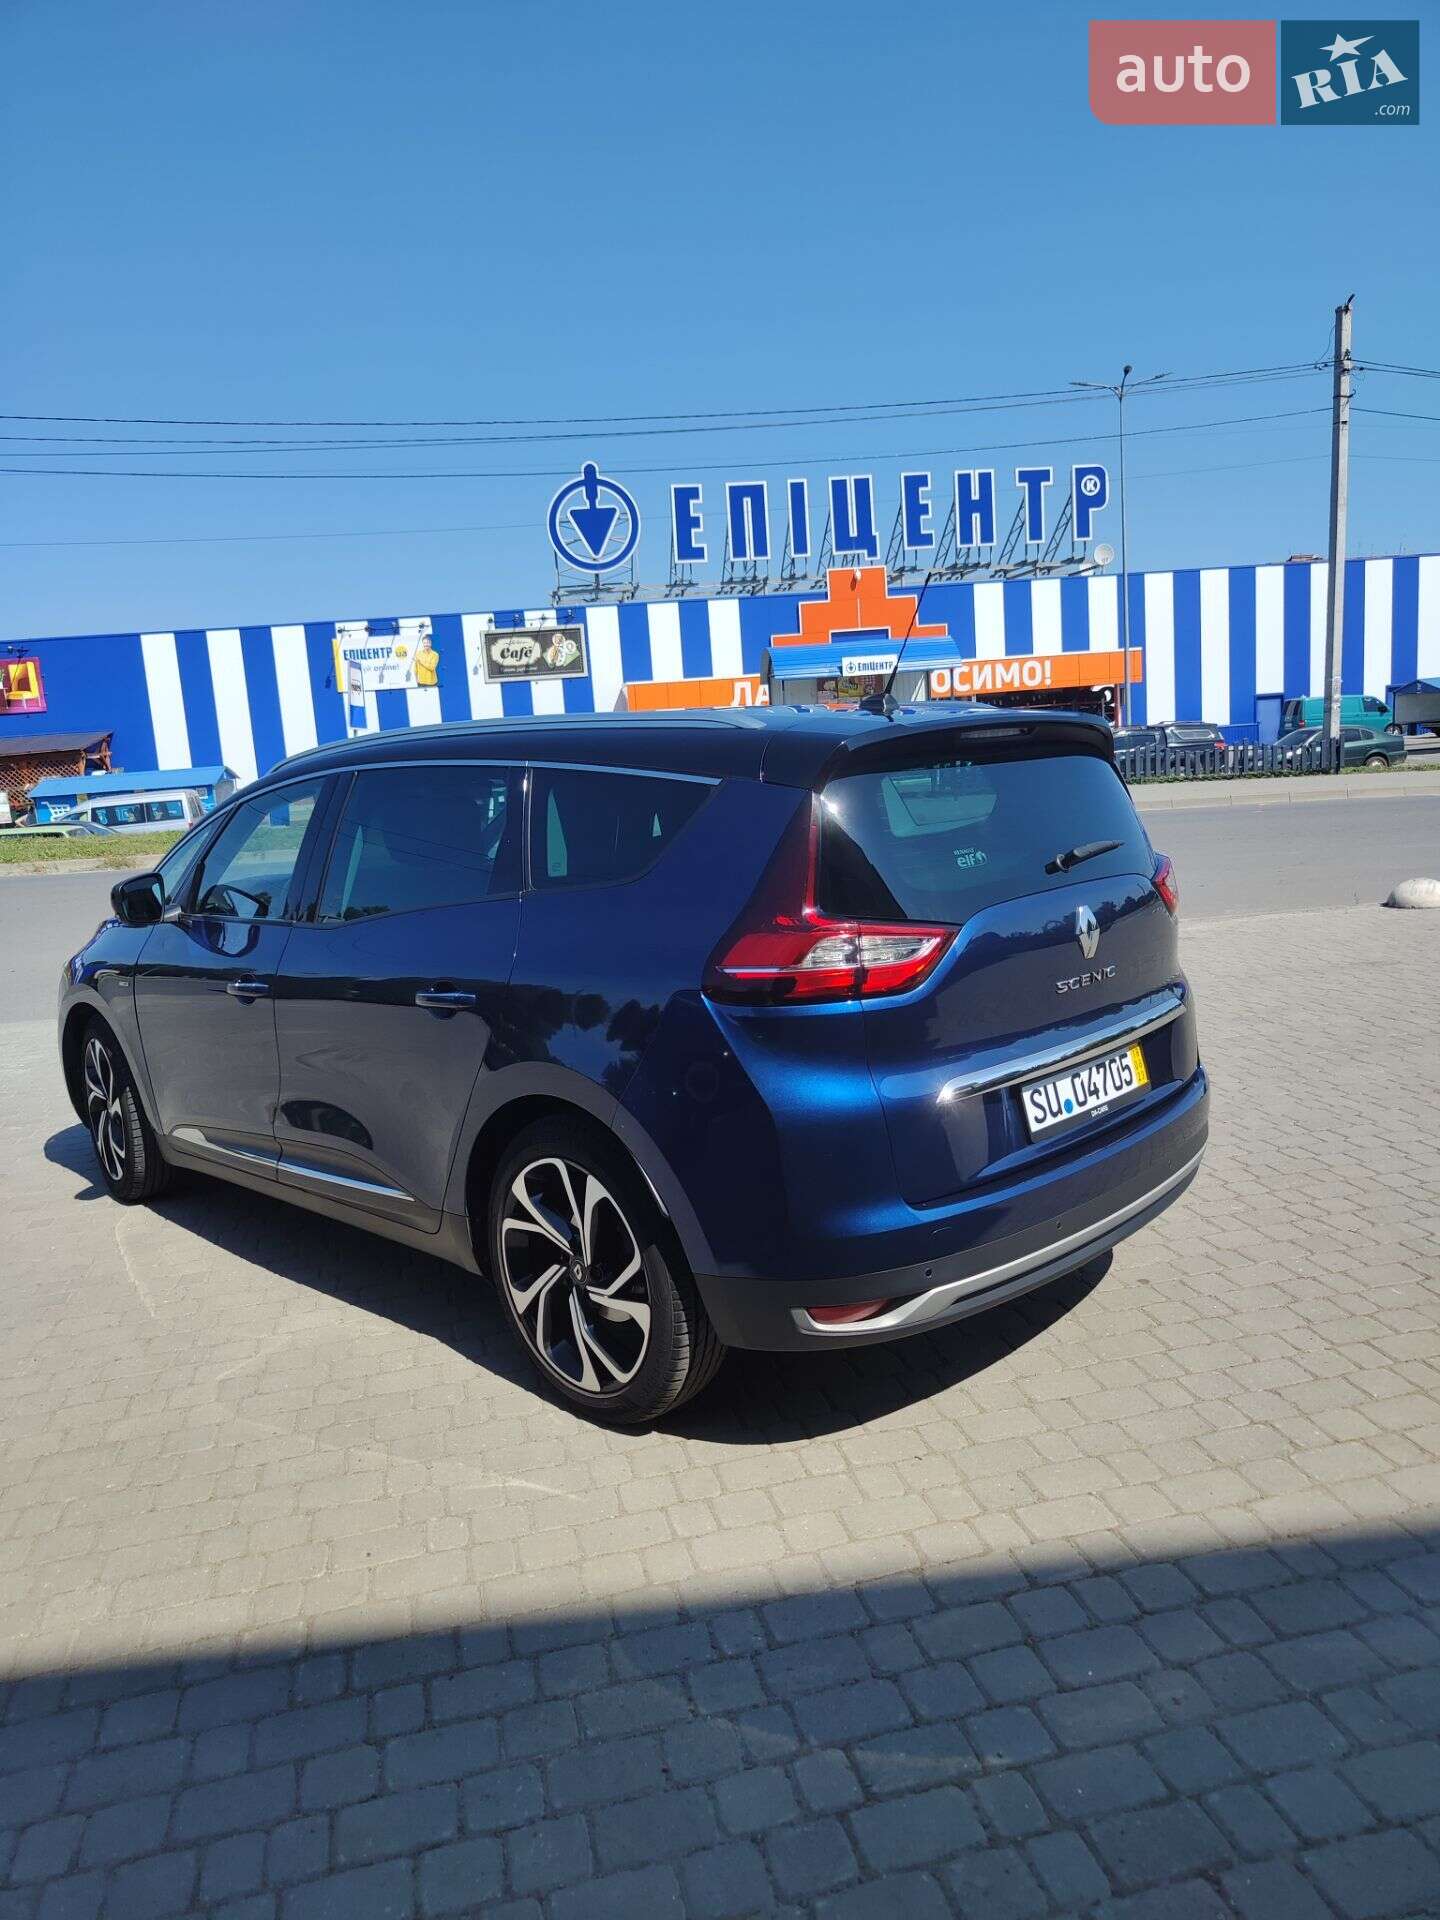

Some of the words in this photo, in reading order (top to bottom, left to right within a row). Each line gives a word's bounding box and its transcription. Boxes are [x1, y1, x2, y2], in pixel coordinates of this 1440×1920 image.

[670, 463, 1110, 563] ЕПІЦЕНТР
[343, 647, 392, 661] ЕПІЦЕНТР
[957, 854, 975, 867] elf
[1055, 965, 1116, 994] SCENIC
[1030, 1082, 1063, 1124] SU
[1071, 1052, 1133, 1107] 04705
